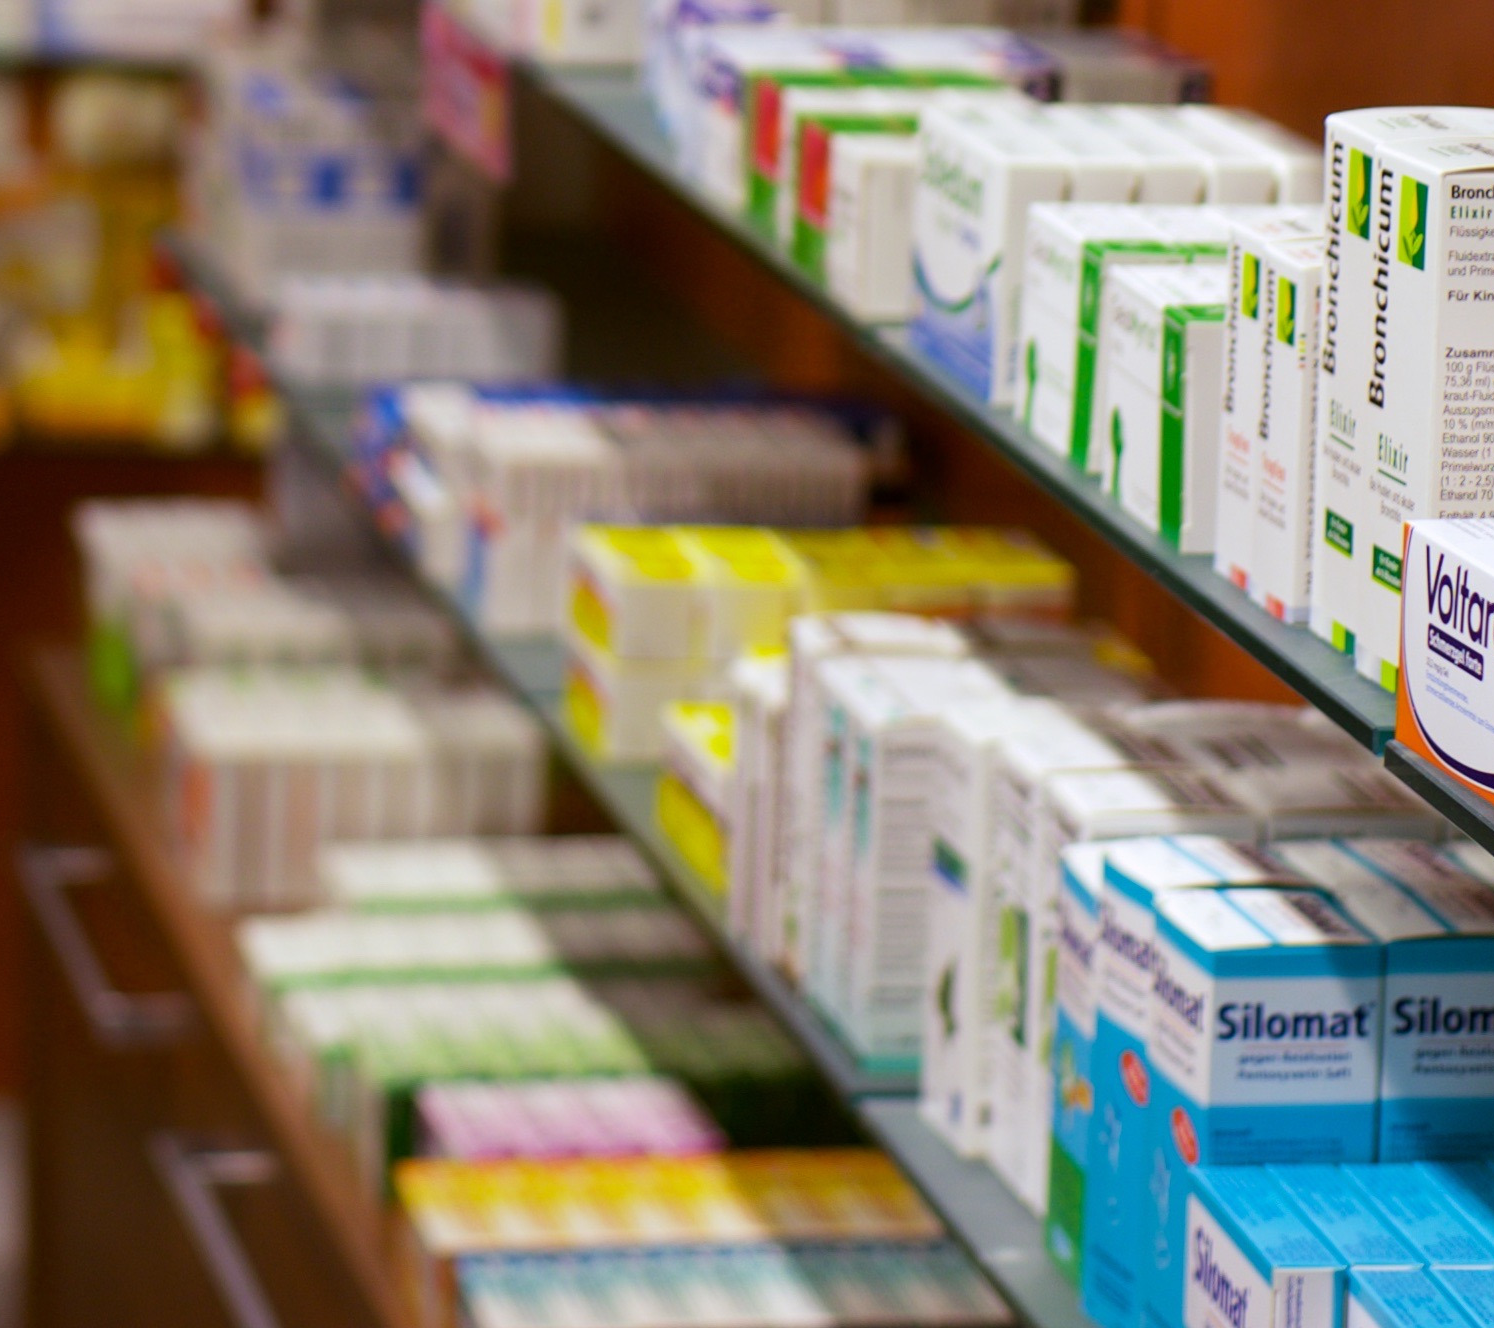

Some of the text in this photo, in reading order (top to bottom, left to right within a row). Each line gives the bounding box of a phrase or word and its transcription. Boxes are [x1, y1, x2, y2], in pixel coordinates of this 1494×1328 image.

[1450, 206, 1492, 219] Elixir
[1448, 266, 1466, 276] und
[1368, 167, 1395, 410] Bronchicum
[1448, 290, 1470, 301] Für
[1445, 362, 1463, 371] 100
[1377, 432, 1409, 474] Elixir
